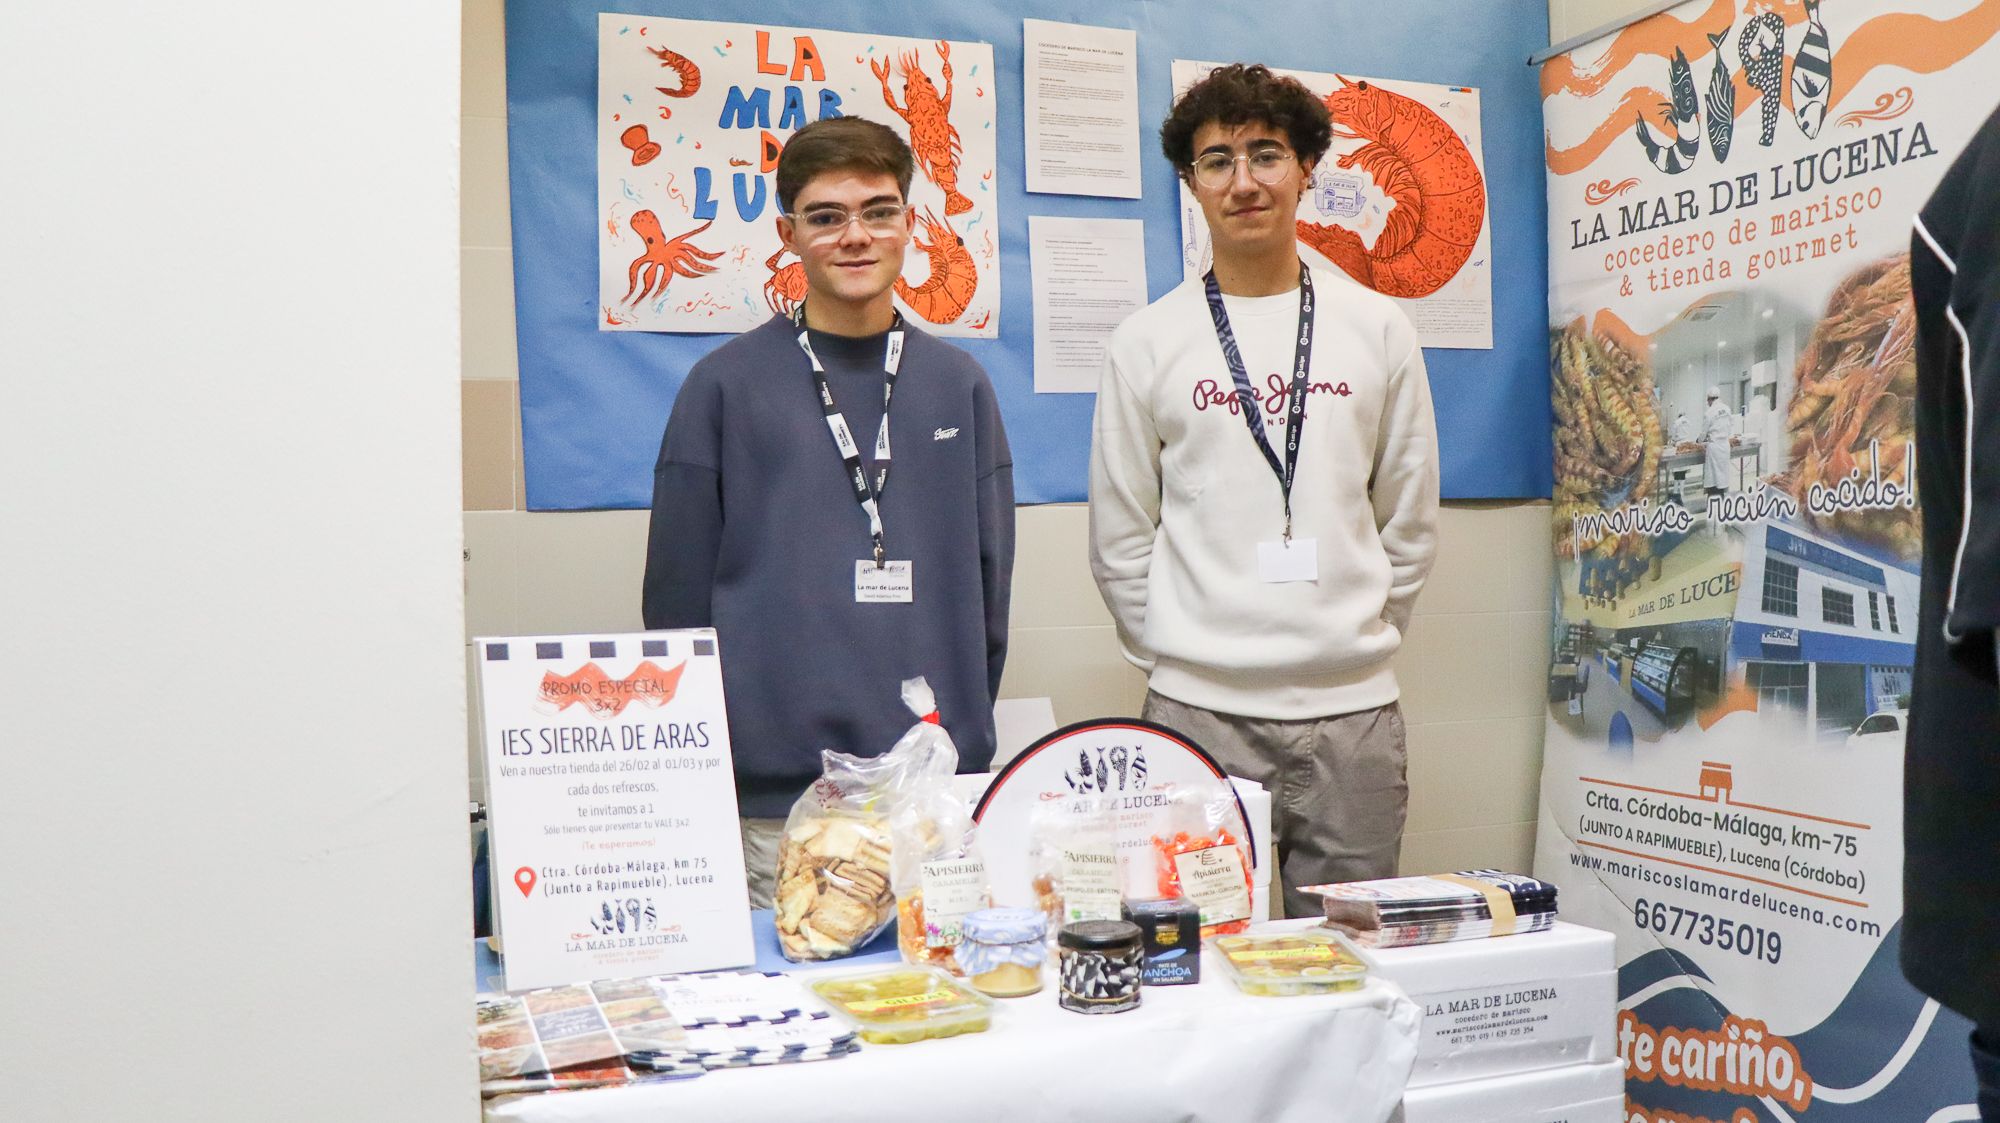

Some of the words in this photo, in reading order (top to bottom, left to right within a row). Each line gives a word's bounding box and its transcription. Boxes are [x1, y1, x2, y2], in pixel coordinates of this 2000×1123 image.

[756, 30, 826, 82] LA
[718, 86, 845, 130] MAR
[1570, 213, 1610, 250] LA
[1618, 189, 1699, 238] MAR
[1708, 171, 1759, 217] DE
[1770, 120, 1939, 202] LUCENA
[1604, 228, 1715, 273] cocedero
[1728, 218, 1757, 245] de
[1770, 185, 1883, 236] marisco
[1619, 273, 1634, 297] &
[1647, 254, 1732, 294] tienda
[1746, 223, 1860, 281] gourmet
[1708, 484, 1797, 523] recién
[1808, 438, 1915, 512] cocido!
[1638, 600, 1655, 616] MAR
[1659, 593, 1675, 611] DE
[542, 681, 593, 696] PROMO
[599, 679, 670, 694] ESPECIAL
[594, 697, 621, 711] 3x2
[501, 728, 533, 756] IES
[540, 726, 615, 755] SIERRA
[622, 724, 647, 751] DE
[653, 721, 710, 750] ARAS
[499, 765, 519, 777] Ven
[521, 768, 527, 776] a
[529, 763, 567, 776] nuestra
[569, 762, 600, 774] tienda
[603, 760, 617, 773] del
[620, 760, 650, 773] 26/02
[652, 760, 661, 770] al
[665, 759, 696, 770] 01/03
[697, 761, 704, 771] y
[705, 758, 721, 770] por
[568, 784, 590, 796] cada
[592, 782, 610, 795] dos
[578, 806, 588, 817] te
[590, 804, 638, 816] invitamos
[640, 806, 646, 814] a
[648, 803, 654, 814] 1
[562, 822, 587, 833] tienes
[588, 824, 603, 834] que
[604, 820, 642, 833] presentar
[644, 820, 653, 829] tu
[654, 818, 672, 828] VALE
[1586, 790, 1624, 814] Crta.
[1626, 797, 1787, 847] Córdoba-Málaga,
[1791, 825, 1858, 858] km-75
[1068, 852, 1118, 865] APISIERRA
[1579, 814, 1624, 840] (JUNTO
[1625, 826, 1634, 841] A
[1635, 828, 1727, 863] RAPIMUEBLE),
[1730, 847, 1781, 874] Lucena
[1783, 855, 1866, 895] (Córdoba)
[542, 866, 570, 878] Ctra.
[674, 858, 690, 869] km
[694, 857, 708, 868] 75
[928, 863, 985, 877] APISIERRA
[1192, 865, 1232, 880] Apisierra
[544, 882, 582, 897] (Junto
[586, 884, 592, 892] a
[676, 874, 714, 886] Lucena
[1570, 853, 1881, 938] www.mariscoslamardelucena.com
[566, 940, 582, 952] LA
[586, 938, 616, 951] MAR
[620, 937, 636, 948] DE
[639, 933, 688, 947] LUCENA
[1634, 897, 1782, 965] 667735019
[1144, 967, 1192, 977] ANCHOA
[1425, 1003, 1444, 1017] LA
[1448, 998, 1480, 1014] MAR
[1484, 995, 1502, 1008] DE
[1505, 987, 1558, 1006] LUCENA
[1455, 1013, 1488, 1024] cocedero
[1502, 1007, 1532, 1018] marisco
[1660, 1025, 1806, 1102] cariño,
